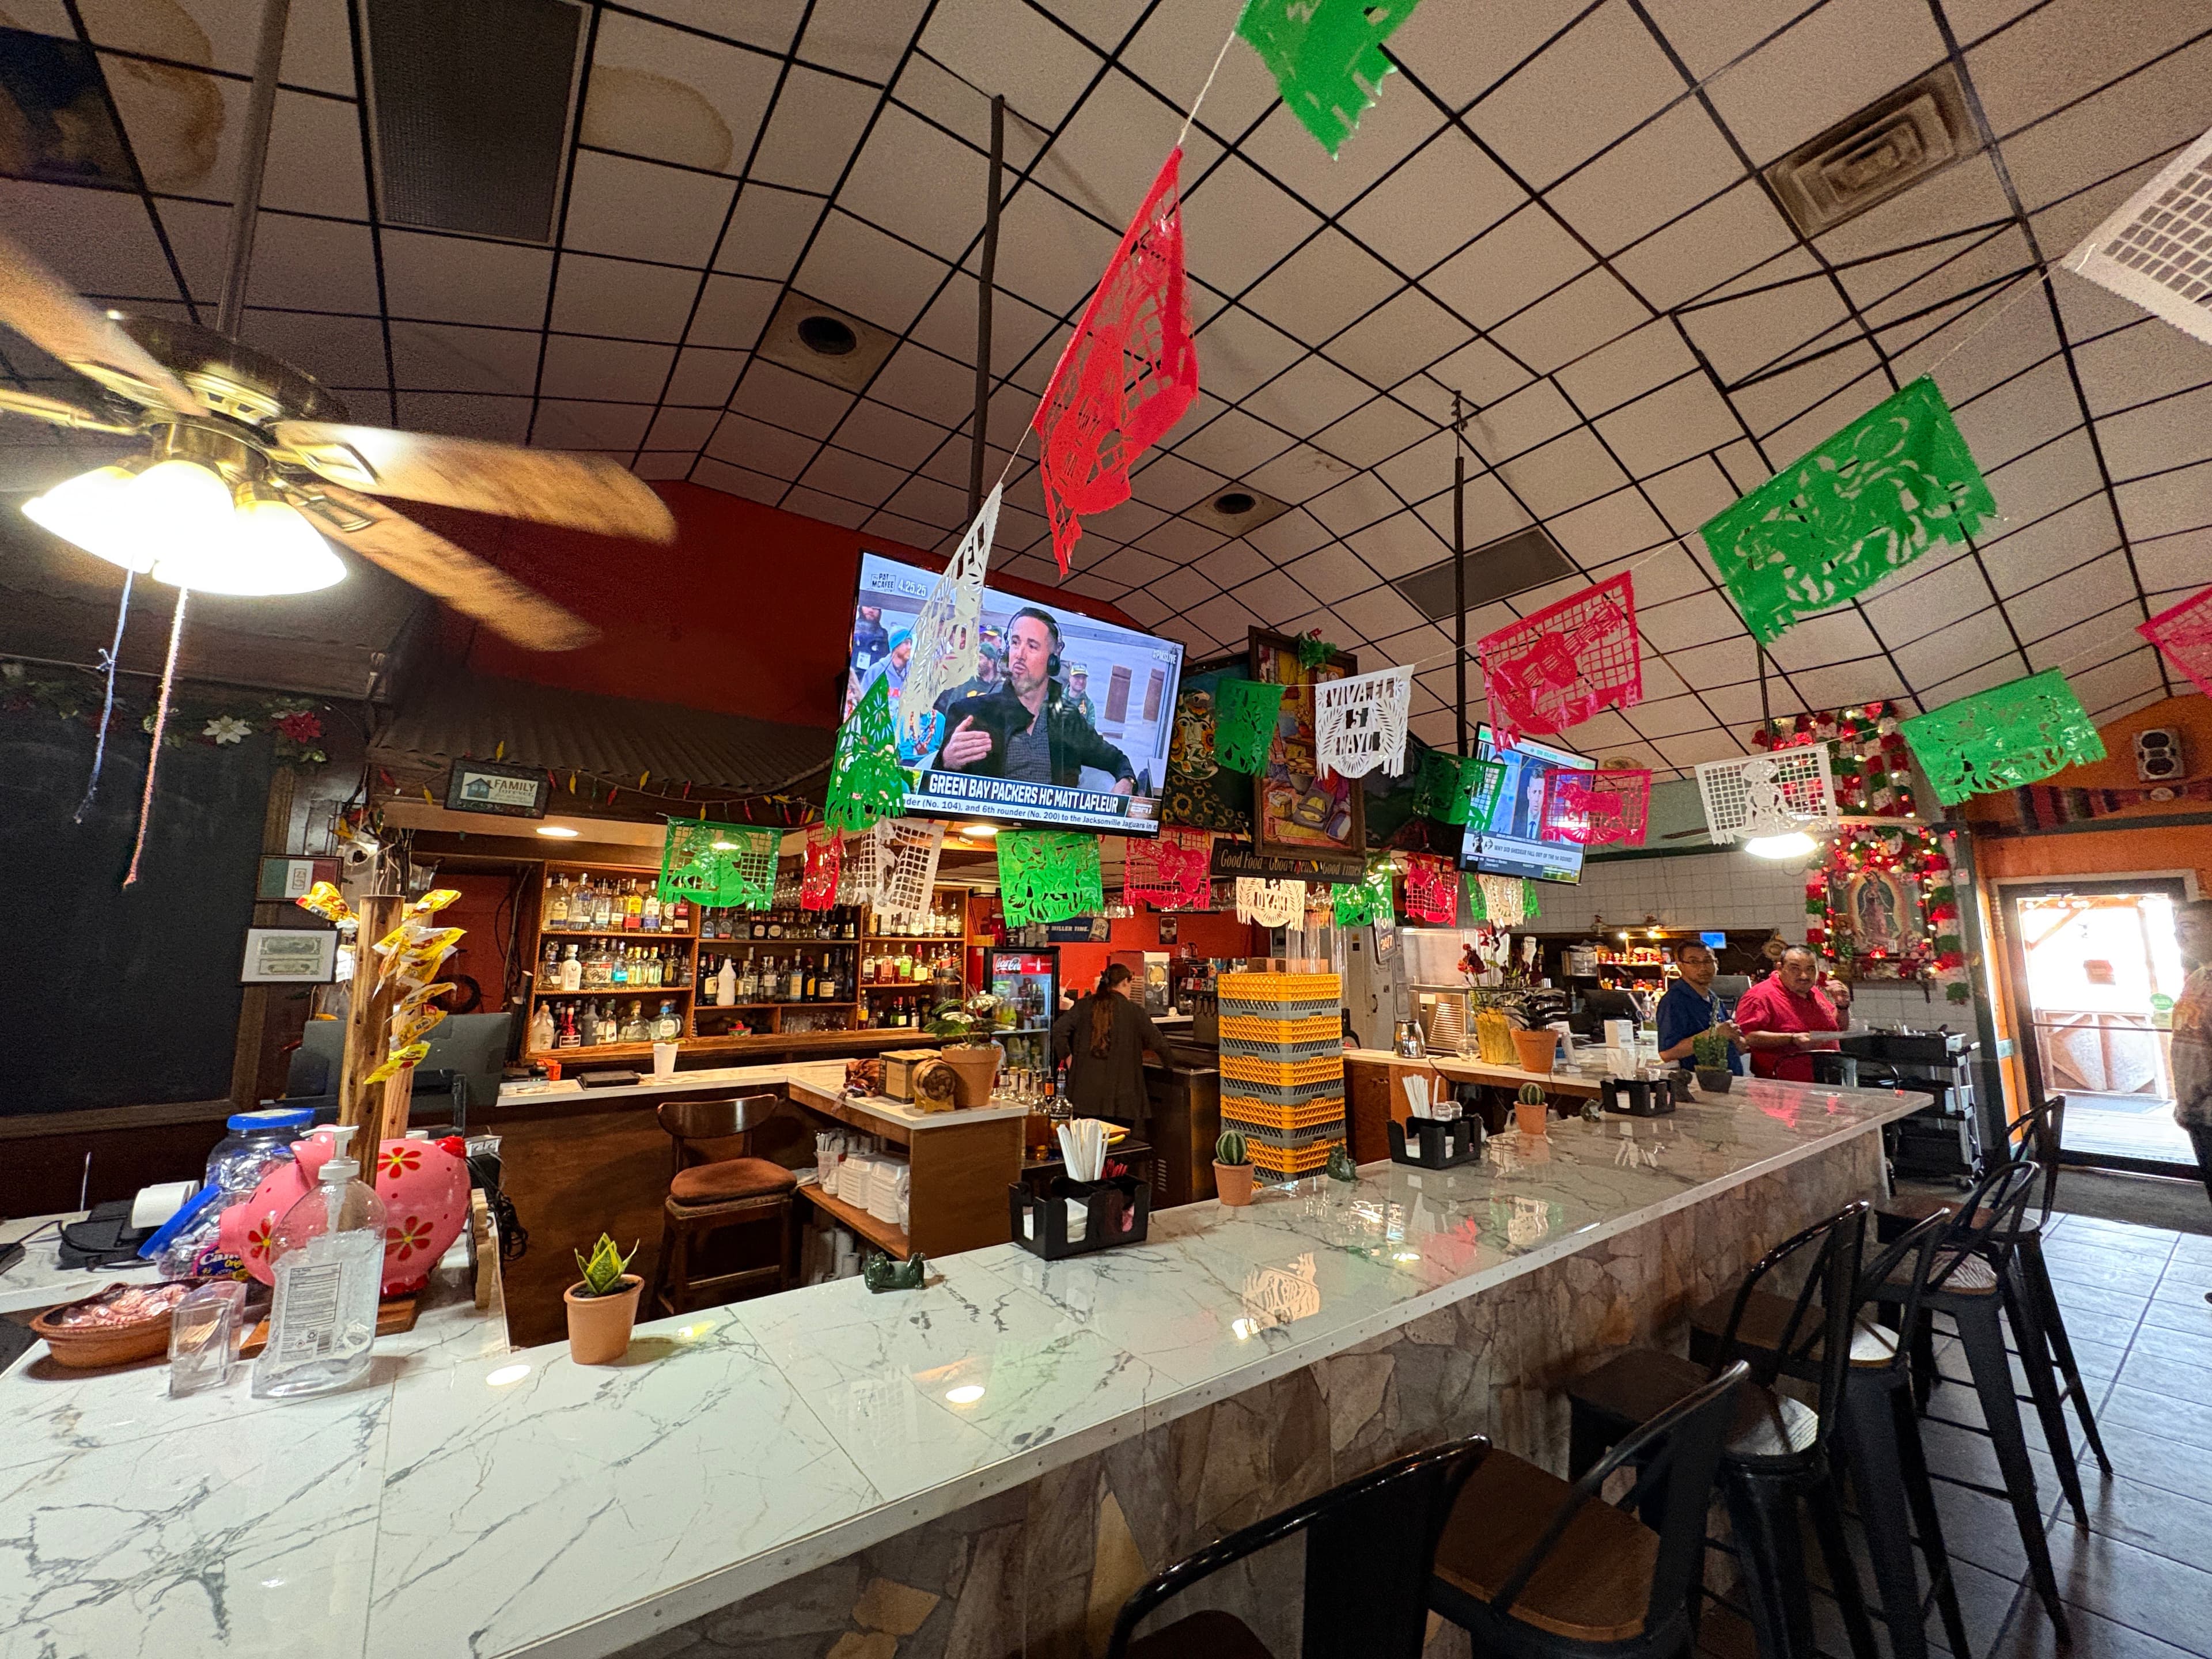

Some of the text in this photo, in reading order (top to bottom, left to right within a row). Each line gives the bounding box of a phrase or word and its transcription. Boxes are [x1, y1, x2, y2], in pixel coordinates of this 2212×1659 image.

[899, 579, 927, 597] 4.25.25
[1329, 682, 1367, 706] VIVA
[494, 779, 536, 792] FAMILY
[929, 774, 1119, 813] GREEN BAY PACKERS HC MATT LAFLEUR
[922, 799, 939, 809] (No.
[941, 801, 963, 812] 104),
[965, 804, 979, 812] and
[982, 805, 995, 814] 6th
[997, 808, 1026, 817] rounder
[1027, 810, 1041, 820] (No.
[1043, 811, 1060, 821] 200)
[1062, 813, 1069, 821] to
[1070, 815, 1081, 823] the
[1082, 816, 1121, 827] Jacksonville
[1122, 819, 1145, 829] Jaguars
[1221, 849, 1241, 868] Good
[1243, 851, 1263, 869] Food
[1323, 862, 1340, 875] Good
